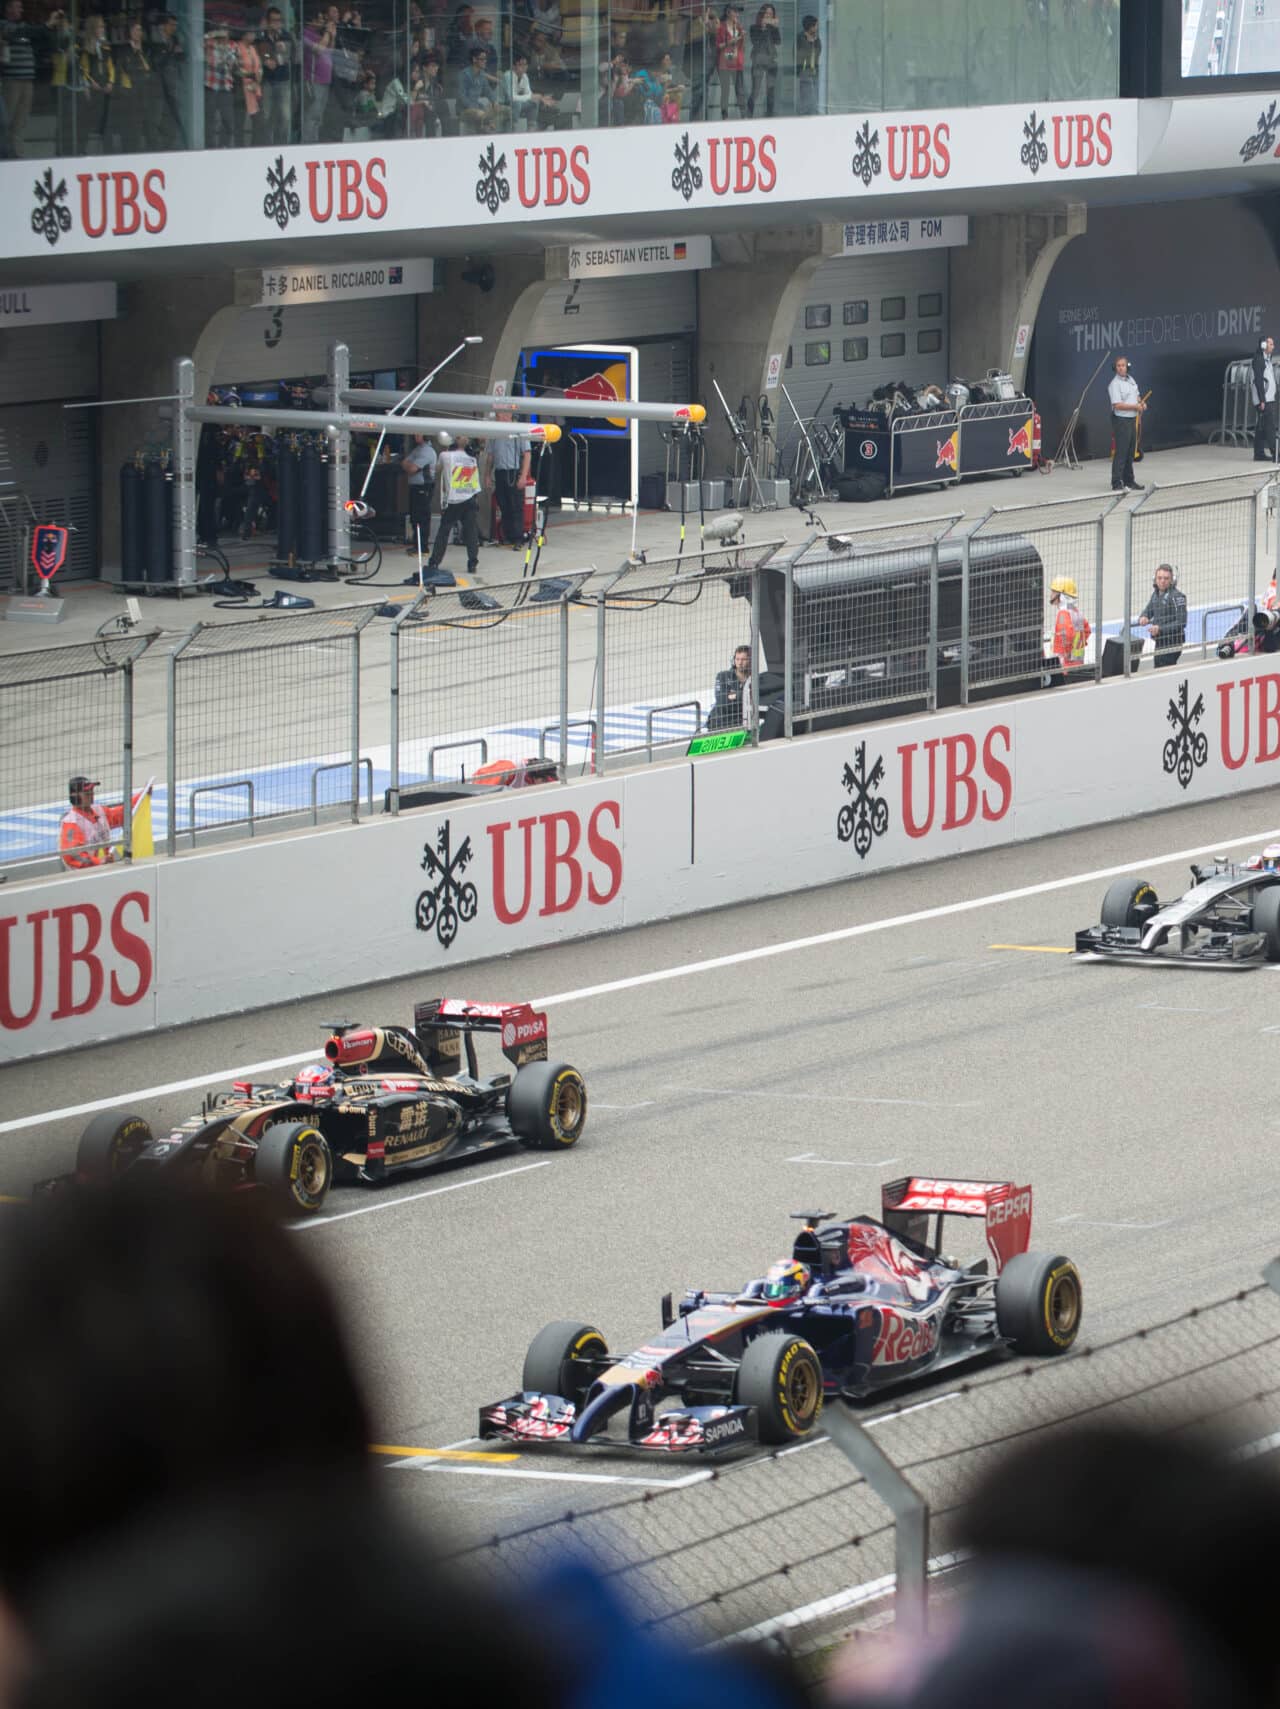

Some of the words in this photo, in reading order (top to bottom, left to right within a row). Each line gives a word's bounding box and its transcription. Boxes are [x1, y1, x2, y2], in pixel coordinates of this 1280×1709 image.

[707, 134, 777, 193] UBS
[886, 123, 951, 180] UBS
[1053, 112, 1112, 168] UBS
[78, 168, 167, 237] UBS
[305, 157, 388, 221] UBS
[514, 144, 590, 207] UBS
[585, 249, 636, 266] SEBASTIAN
[637, 245, 671, 262] VETTEL
[844, 221, 910, 247] 管理有限公司
[920, 219, 942, 238] FOM
[263, 275, 288, 296] 卡多
[291, 274, 329, 293] DANIEL
[331, 270, 385, 289] RICCIARDO
[1127, 314, 1181, 347] BEFORE
[1183, 311, 1215, 339] YOU
[897, 724, 1013, 839] UBS
[486, 799, 623, 925] UBS
[0, 891, 153, 1030] UBS
[517, 1020, 545, 1039] PDVSA
[384, 1126, 431, 1147] RENAULT
[987, 1190, 1031, 1228] CEPSA
[705, 1417, 745, 1443] SAPINDA
